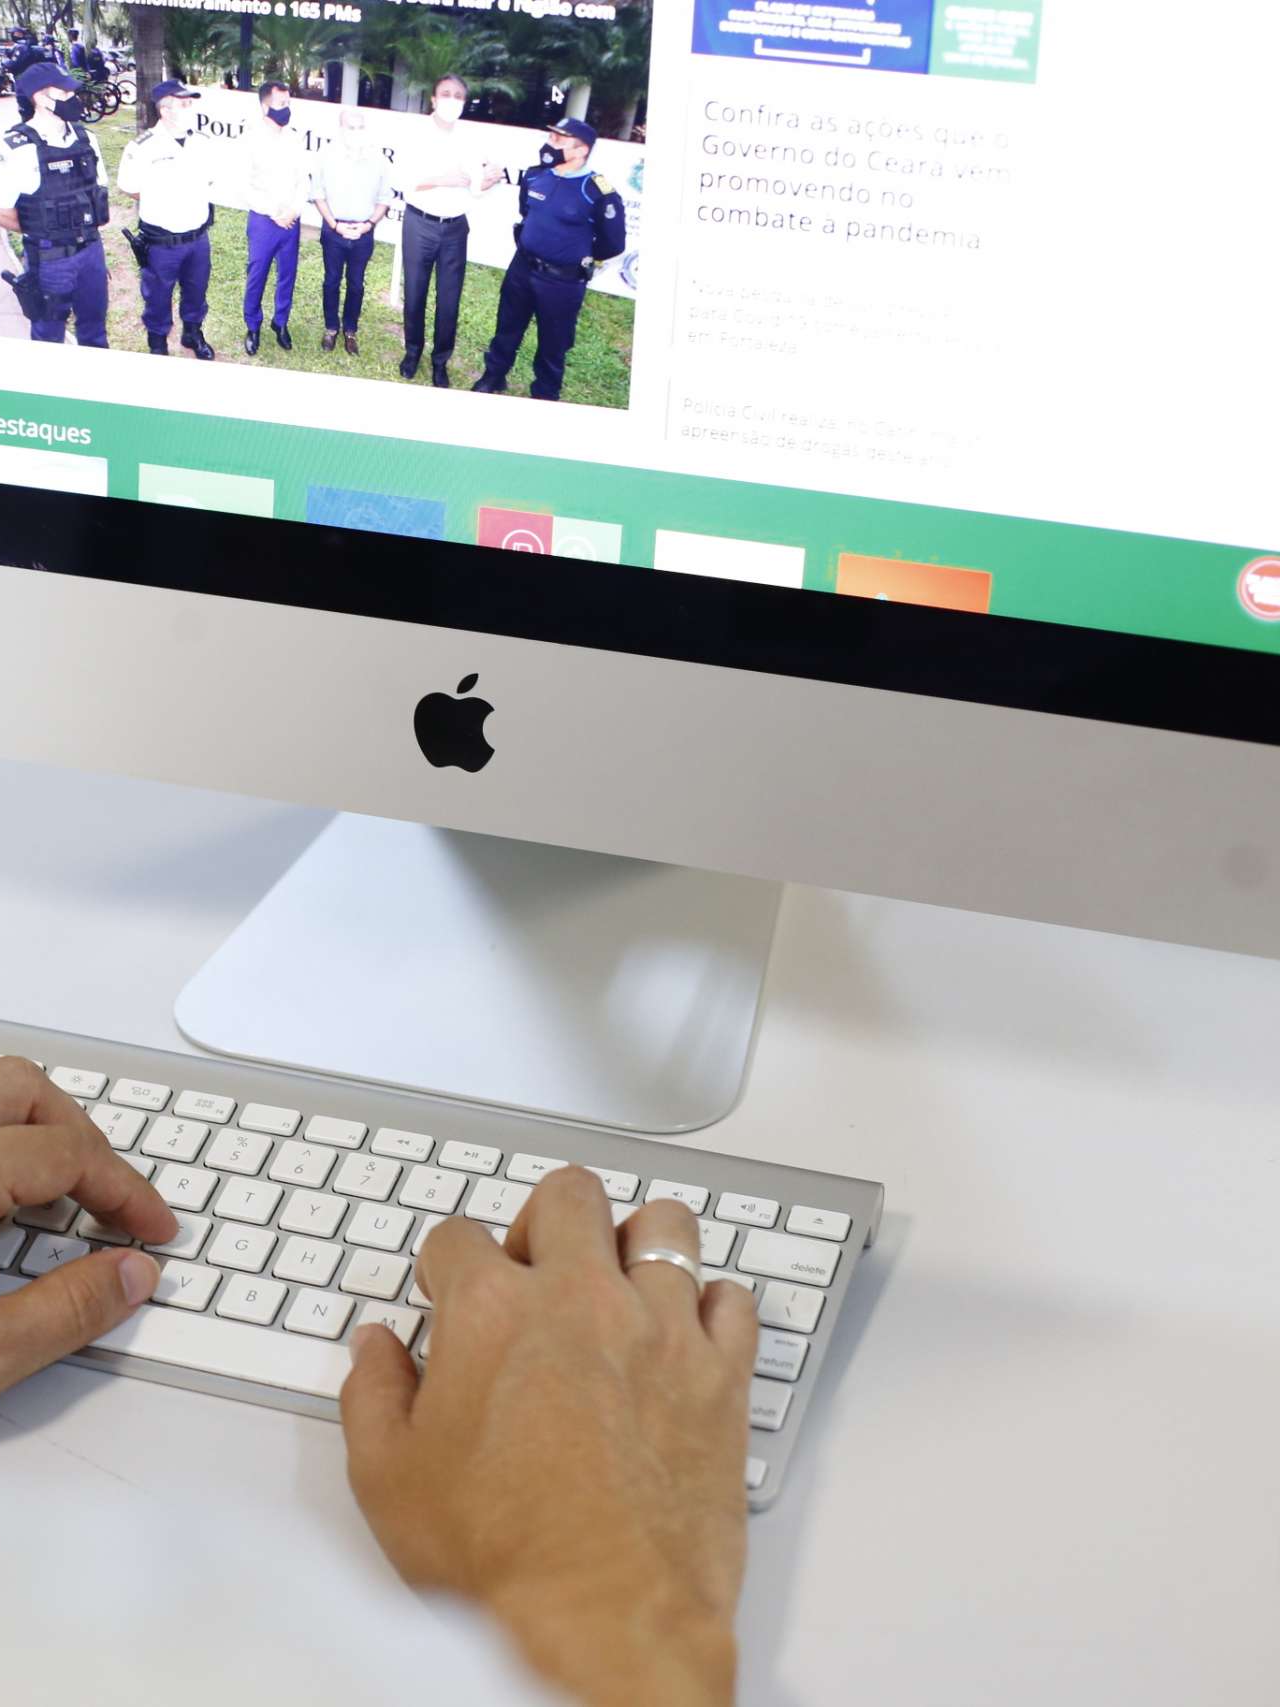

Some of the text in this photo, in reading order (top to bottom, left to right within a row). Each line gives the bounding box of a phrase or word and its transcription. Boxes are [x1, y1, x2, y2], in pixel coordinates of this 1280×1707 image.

[274, 2, 286, 17] e
[289, 1, 321, 20] 165
[323, 3, 363, 23] PMs
[574, 3, 616, 20] com
[704, 100, 800, 130] Confira
[810, 115, 838, 135] as
[702, 133, 815, 166] Governo
[824, 146, 857, 170] do
[699, 171, 915, 209] promovendo no
[697, 204, 813, 234] combate
[846, 221, 982, 251] pandemia
[167, 1138, 178, 1147] 4
[236, 1135, 249, 1148] %
[293, 1164, 304, 1175] 6
[365, 1161, 377, 1172] &
[177, 1178, 190, 1190] R
[359, 1175, 372, 1186] 7
[245, 1191, 256, 1203] T
[424, 1188, 437, 1199] 8
[310, 1204, 321, 1217] Y
[492, 1201, 502, 1212] 9
[373, 1217, 389, 1230] U
[234, 1239, 249, 1251] G
[47, 1247, 64, 1262] X
[300, 1251, 317, 1265] H
[369, 1265, 381, 1278] J
[790, 1261, 827, 1277] delete
[180, 1275, 193, 1289] V
[245, 1289, 258, 1302] B
[312, 1303, 328, 1317] N
